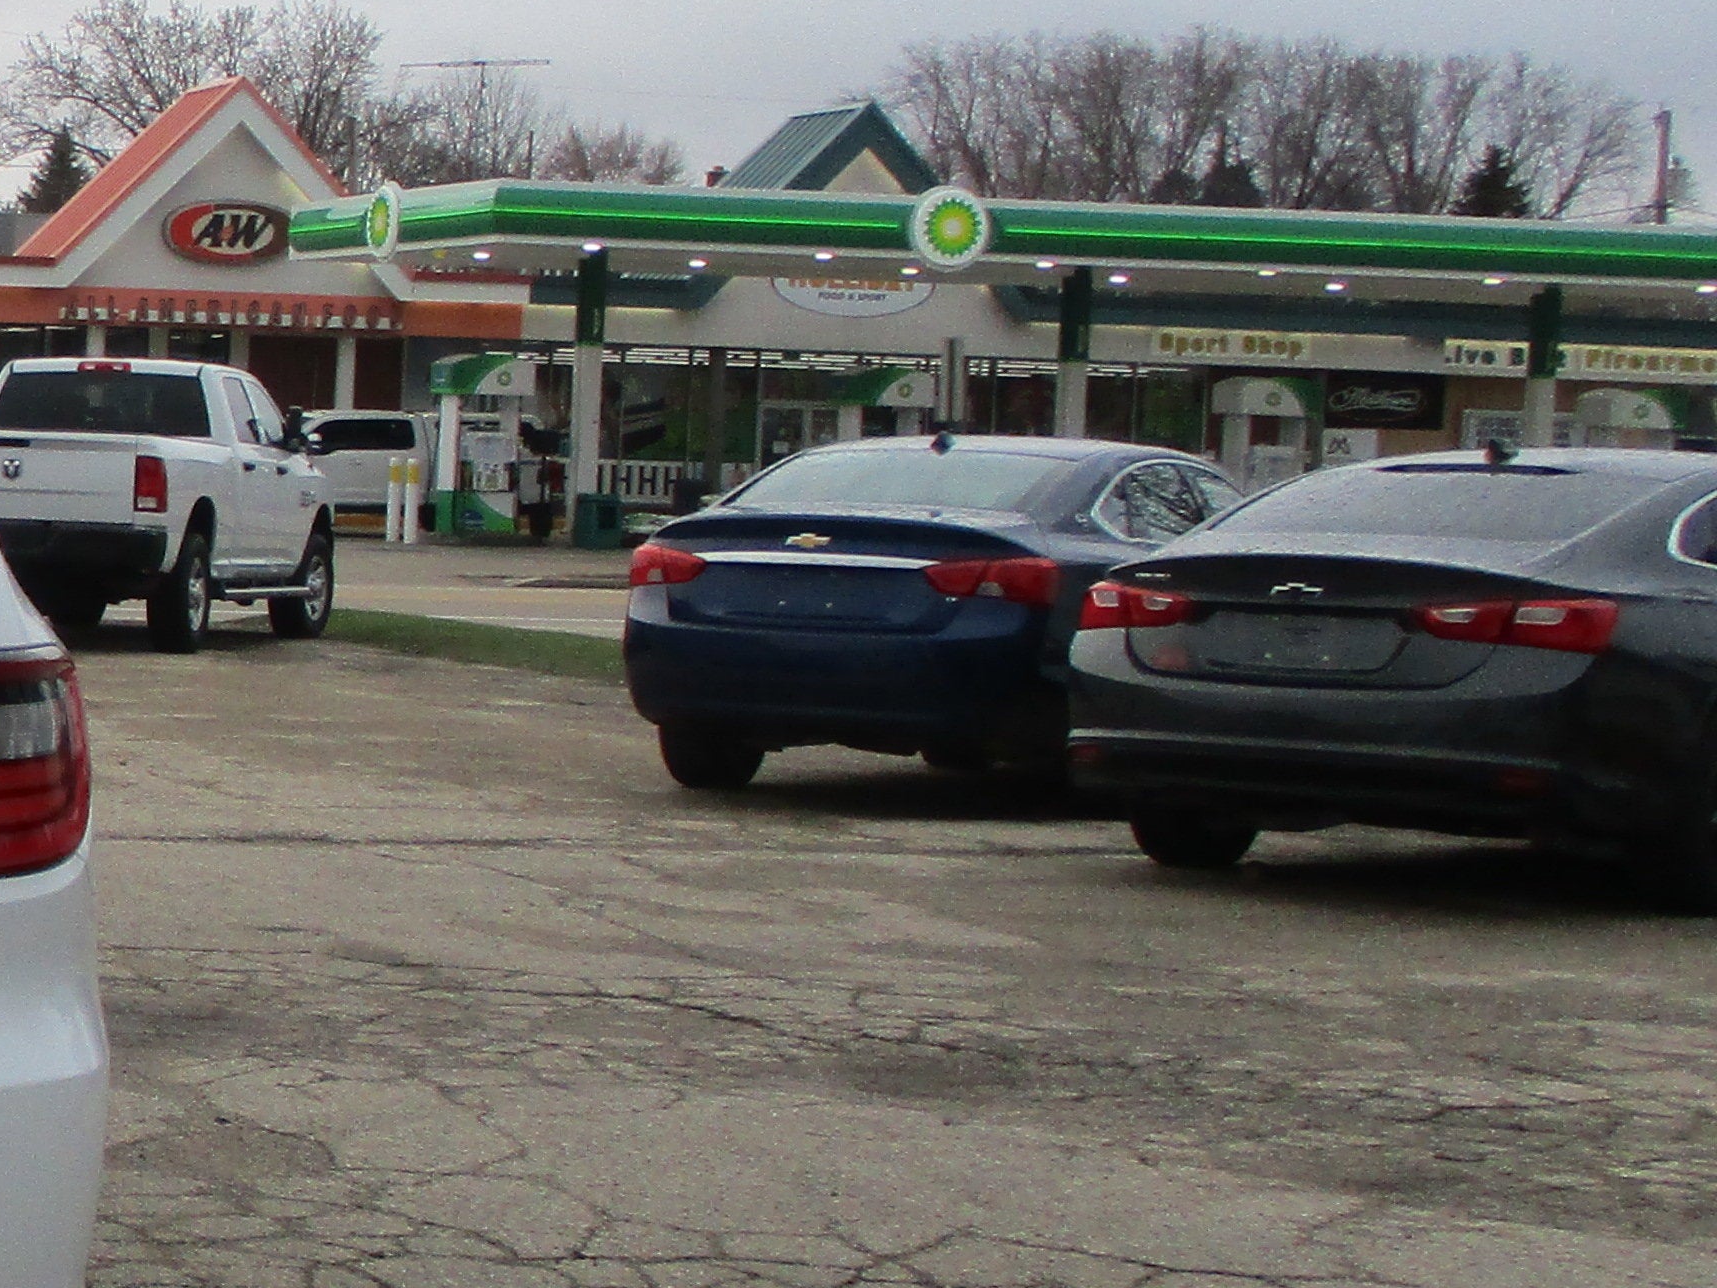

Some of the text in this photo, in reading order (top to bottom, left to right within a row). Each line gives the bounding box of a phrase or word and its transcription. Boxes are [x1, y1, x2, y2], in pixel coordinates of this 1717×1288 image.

[193, 213, 272, 250] A&W
[1159, 331, 1303, 360] Sport Shop
